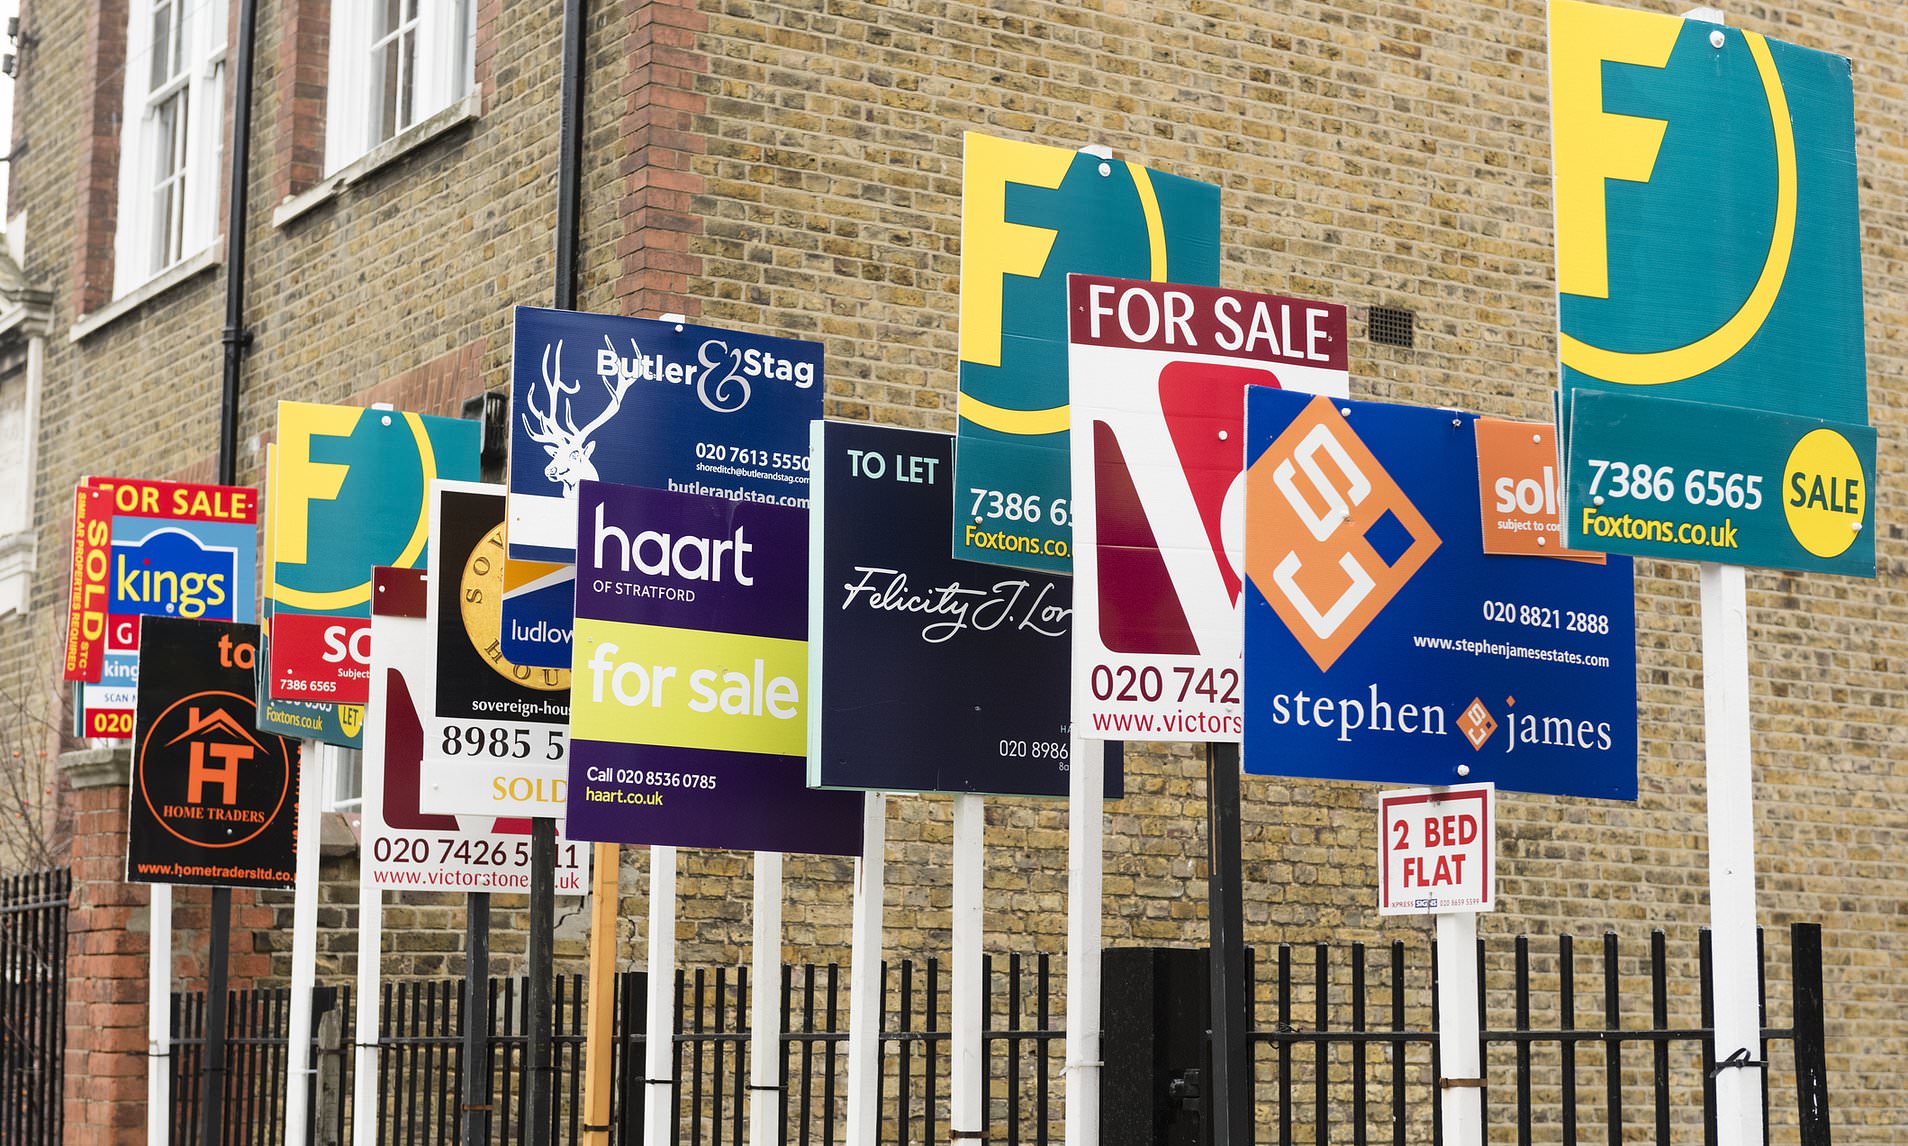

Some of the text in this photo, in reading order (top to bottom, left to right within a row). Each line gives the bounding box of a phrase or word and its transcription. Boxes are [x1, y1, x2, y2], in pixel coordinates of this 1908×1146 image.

[1089, 284, 1330, 362] FOR SALE
[597, 349, 697, 385] Butler
[743, 348, 814, 389] Stag
[695, 442, 811, 472] 020 7613 5550
[847, 450, 939, 485] TO LET
[99, 482, 247, 519] OR SALE
[668, 478, 810, 509] butlerandstag.com
[1495, 466, 1560, 514] sol
[1588, 459, 1762, 511] 7386 6565
[1790, 472, 1859, 515] SALE
[970, 487, 1073, 527] 7386 6
[965, 525, 1072, 558] Foxtons.co.
[1498, 518, 1532, 532] subject
[1534, 520, 1544, 531] to
[1582, 506, 1739, 550] Foxtons.co.uk
[593, 501, 754, 587] haart
[67, 492, 87, 672] SIMILAR PROPERTIES REQUIRED
[79, 519, 109, 669] SOLD STC
[117, 553, 226, 619] kings
[593, 580, 696, 603] OF STRATFORD
[841, 566, 988, 644] Felicity
[1483, 600, 1609, 634] 020 8821 2888
[218, 633, 255, 669] to
[322, 625, 371, 665] SO
[1413, 634, 1609, 668] www.stephenjamesestates.com
[280, 679, 337, 692] 7386 6565
[337, 667, 370, 680] Subject
[588, 642, 799, 720] for sale
[1091, 664, 1240, 704] 020 742
[104, 693, 128, 703] SCAN
[472, 698, 571, 718] sovereign-hou
[94, 713, 133, 733] 020
[266, 706, 322, 732] Foxtons.co.uk
[343, 705, 358, 727] LET
[1272, 683, 1612, 754] stephen james
[442, 725, 565, 760] 8985 5
[999, 740, 1068, 759] 020 8986
[187, 741, 254, 805] HT
[492, 776, 567, 803] SOLD
[587, 767, 716, 790] Call 020 8536 0785
[586, 787, 663, 806] haart.co.uk
[163, 806, 265, 823] HOME TRADERS
[1393, 814, 1477, 850] 2 BED
[374, 837, 579, 869] 020 7426 511
[374, 870, 579, 889] www.victorstone..uk
[1403, 854, 1466, 888] FLAT
